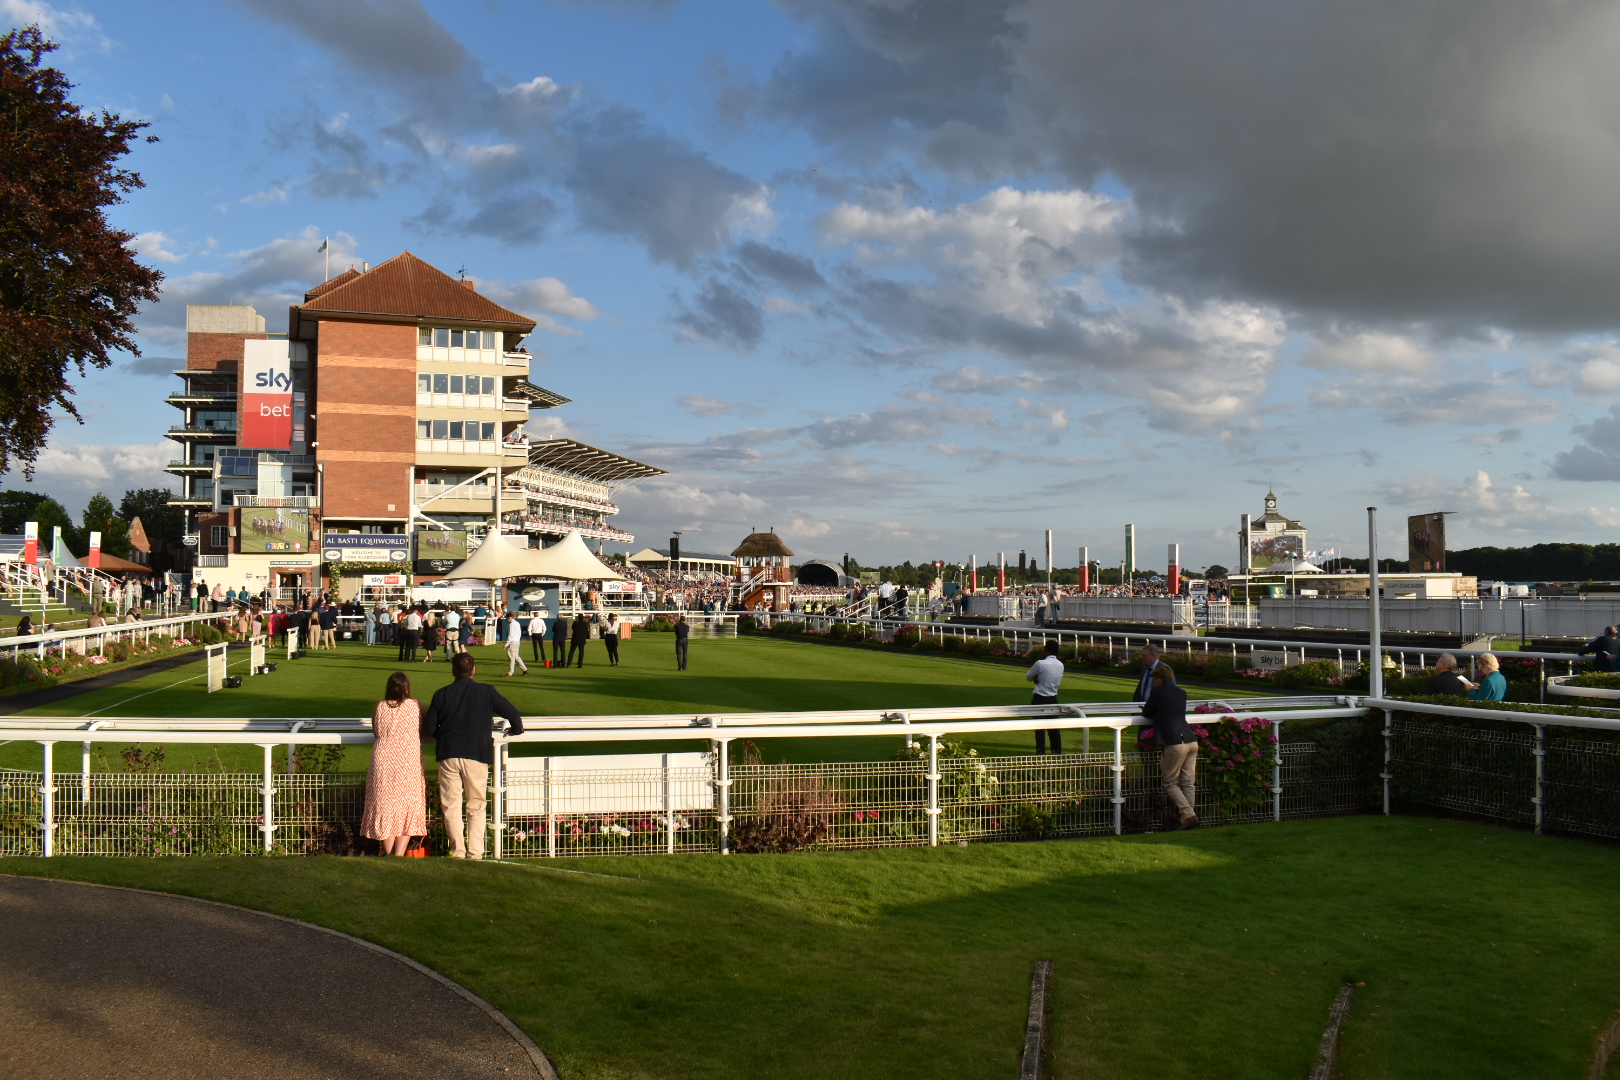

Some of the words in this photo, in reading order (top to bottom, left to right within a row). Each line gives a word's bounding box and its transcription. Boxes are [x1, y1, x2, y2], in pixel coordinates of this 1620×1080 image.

[256, 368, 292, 392] sky
[260, 402, 290, 417] bet
[1260, 654, 1273, 666] sky
[1274, 655, 1285, 665] be
